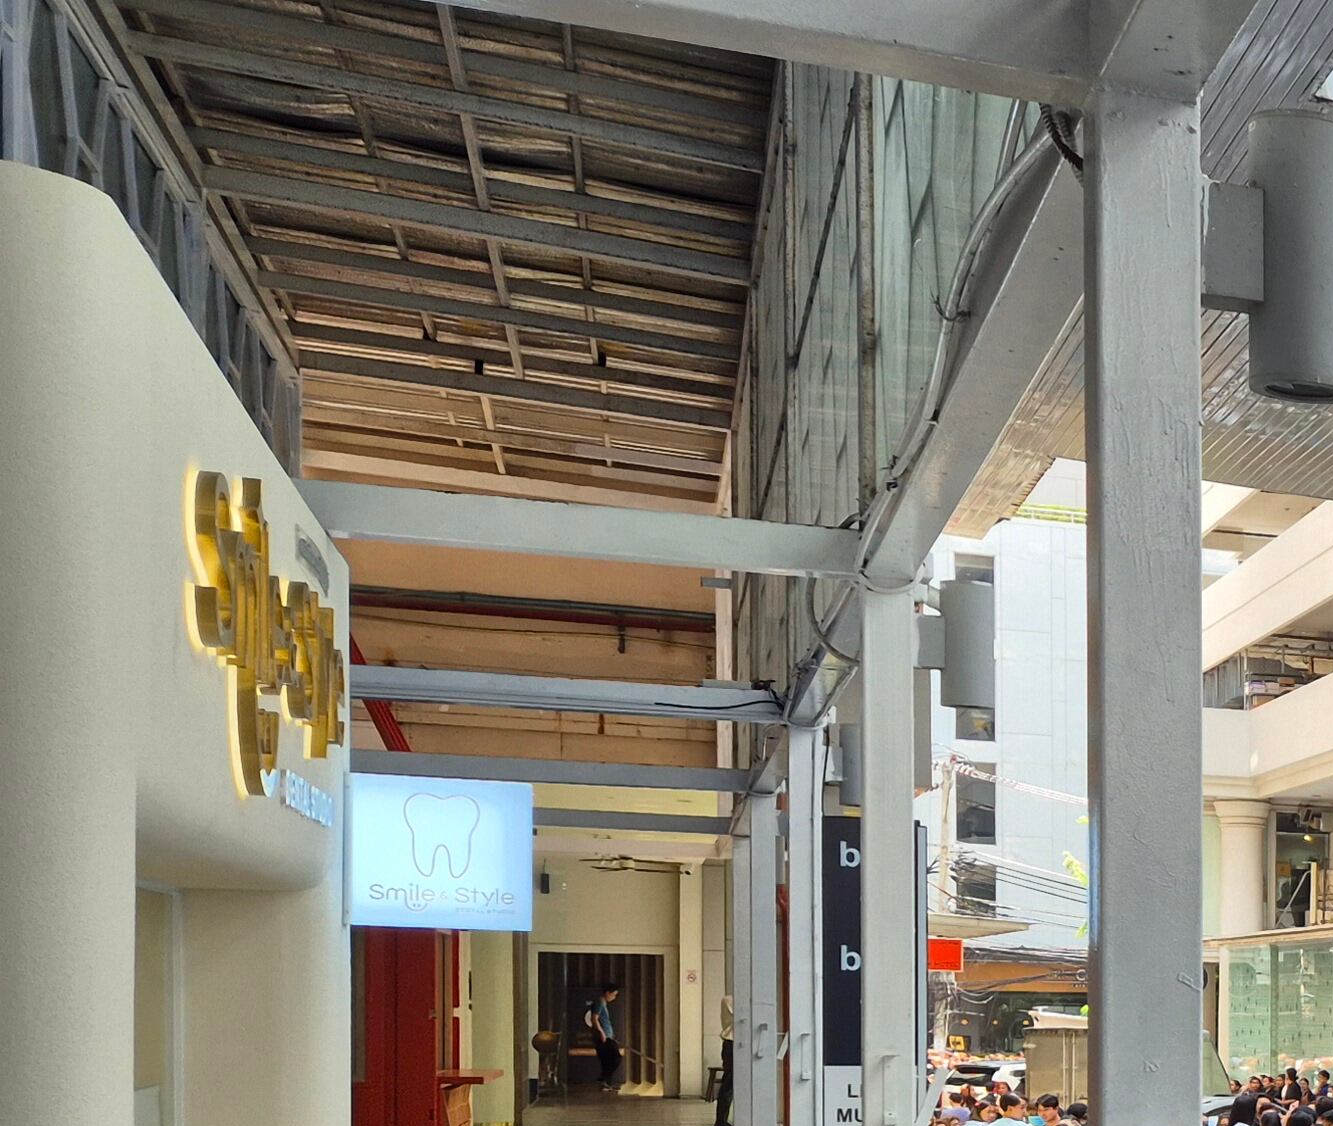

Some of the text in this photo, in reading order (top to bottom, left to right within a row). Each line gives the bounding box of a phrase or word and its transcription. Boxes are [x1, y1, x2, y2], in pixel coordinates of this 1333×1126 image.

[368, 882, 436, 908] Smile
[455, 887, 515, 907] Style
[847, 1083, 862, 1098] L
